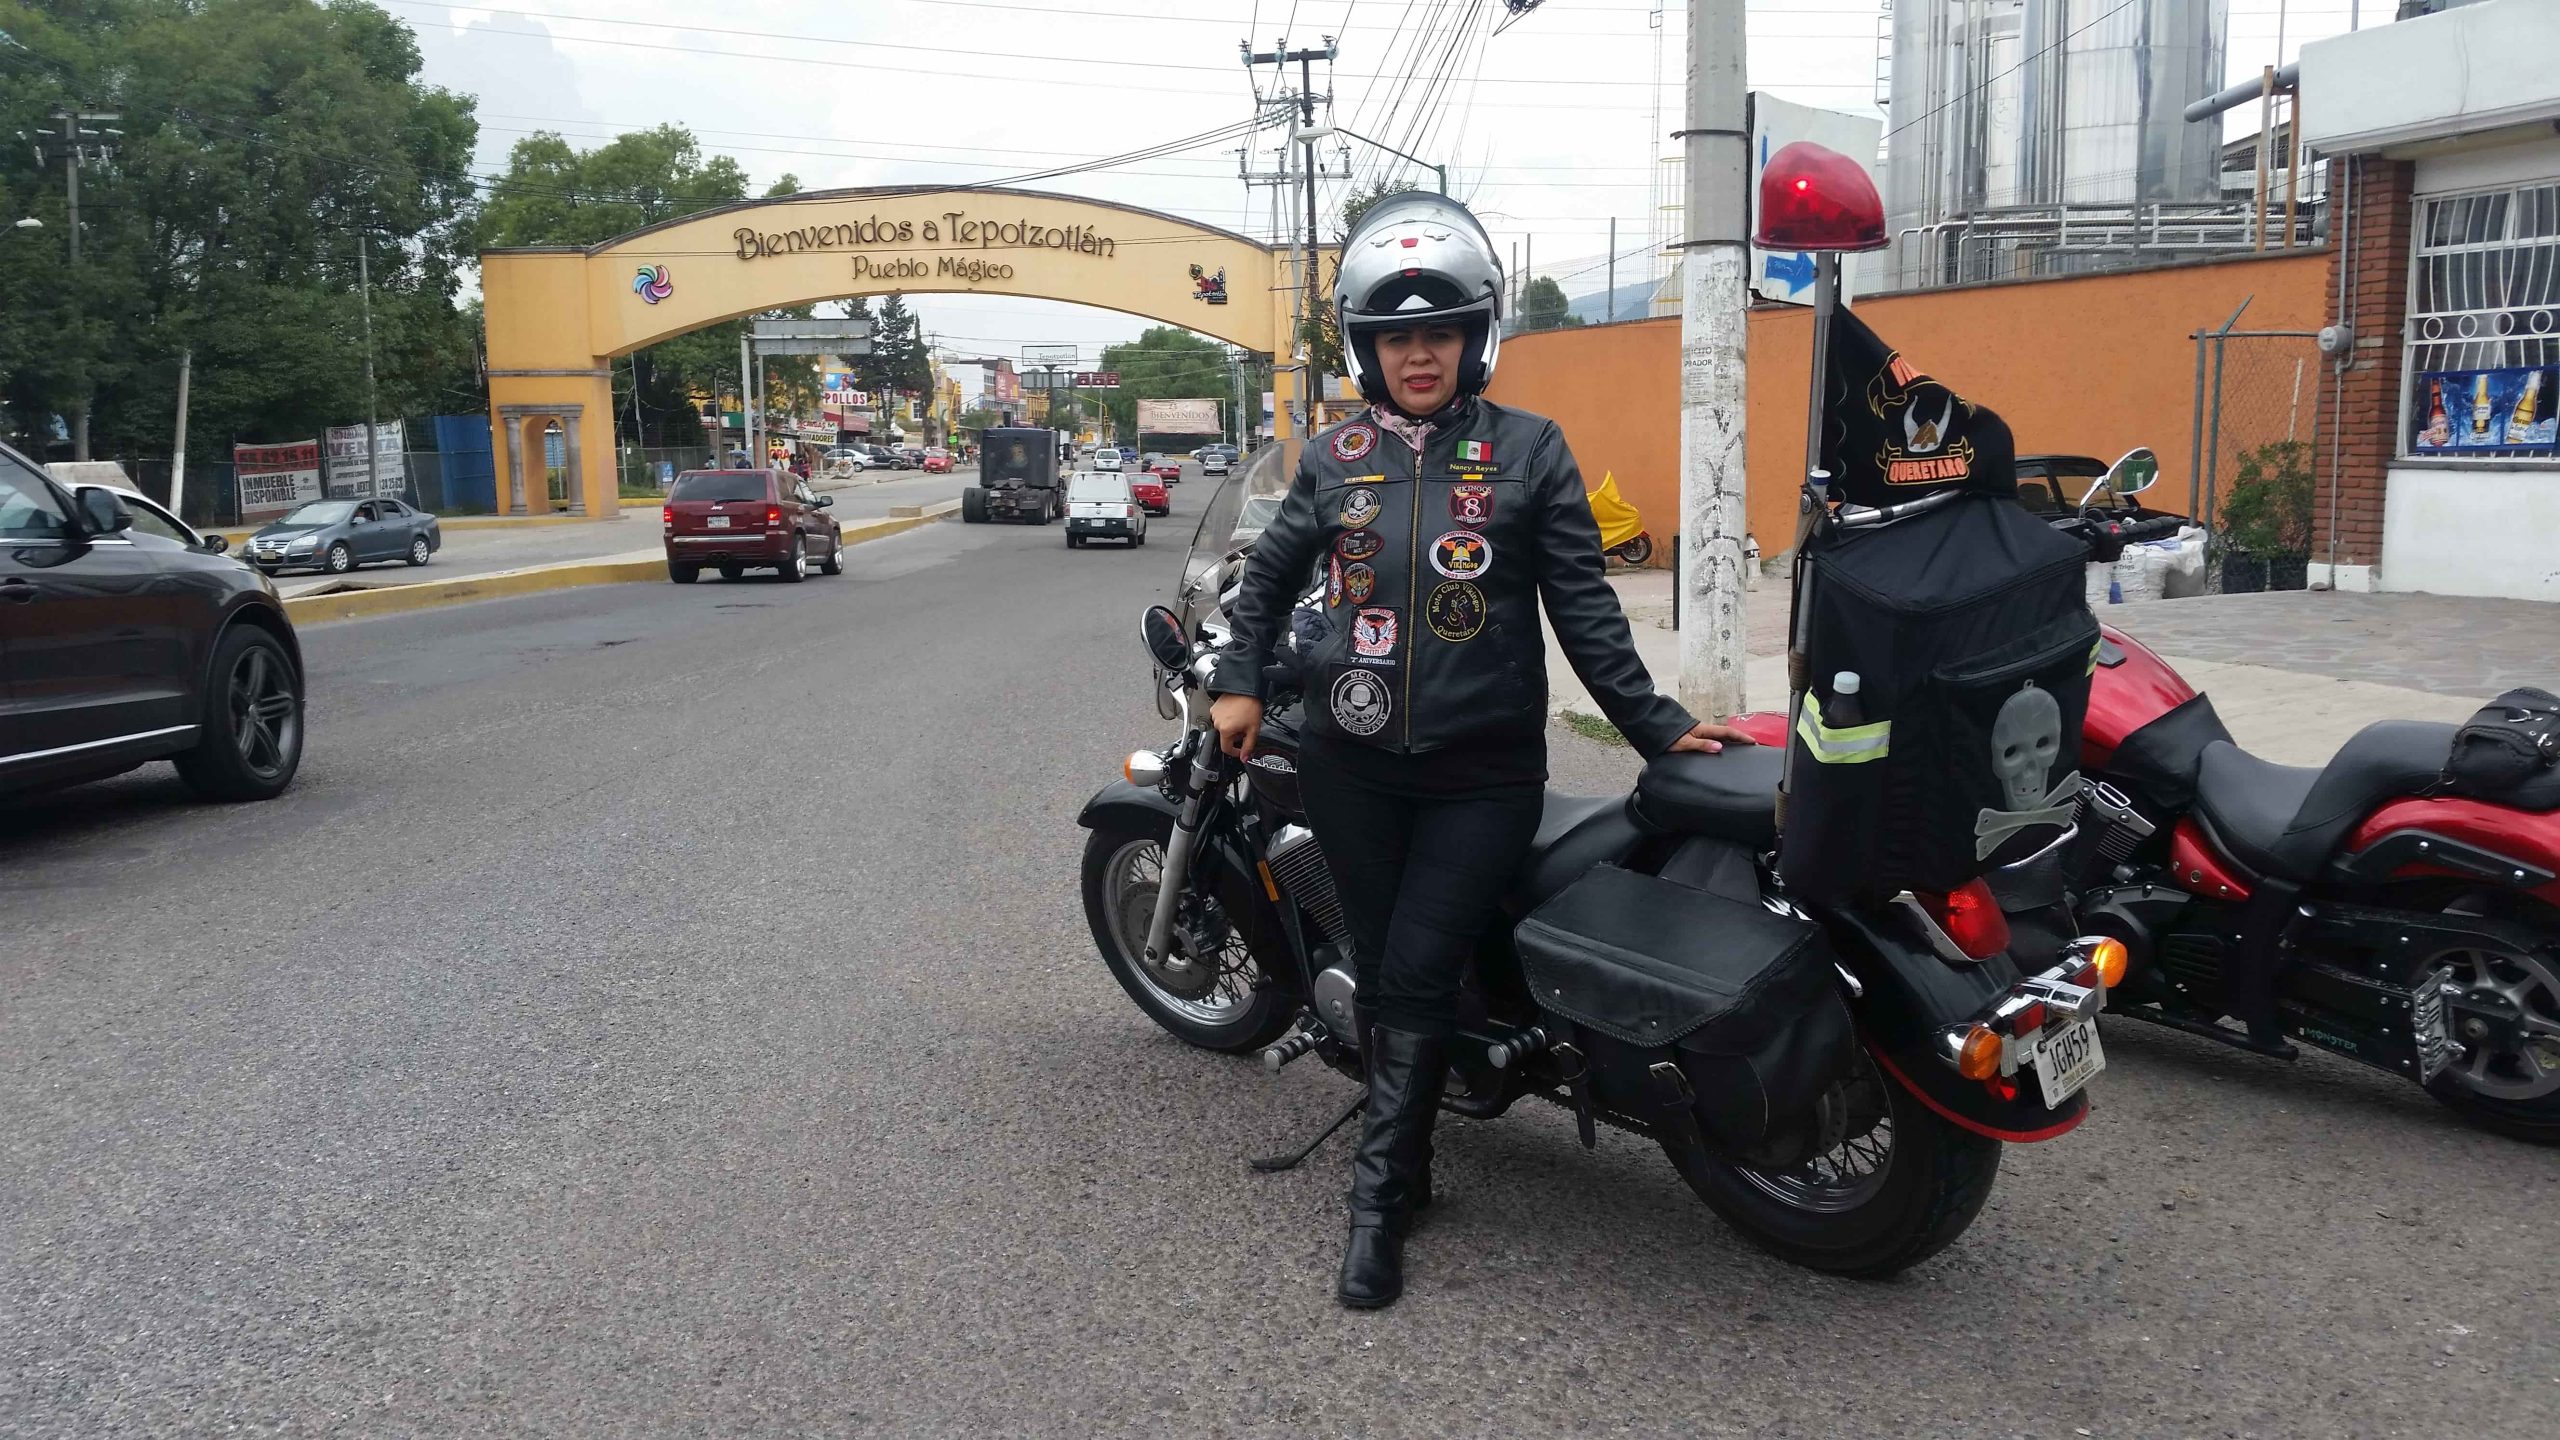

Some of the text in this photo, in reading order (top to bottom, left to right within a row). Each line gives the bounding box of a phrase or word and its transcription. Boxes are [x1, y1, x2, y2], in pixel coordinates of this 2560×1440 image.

[734, 210, 1115, 260] Bienvenidos a Tepotzotlán
[852, 255, 1014, 282] Pueblo Mágico
[825, 392, 866, 405] POLLOS
[1449, 464, 1472, 472] Nancy
[1888, 457, 1967, 482] QUERETARO
[242, 474, 295, 491] INMUEBLE
[1453, 485, 1492, 494] VIKINGOS
[244, 488, 297, 504] DISPONIBLE
[1465, 498, 1480, 517] 8
[1455, 514, 1488, 524] ANIVERSARIO
[1432, 582, 1480, 613] Moto Club Vikingos
[1437, 625, 1475, 638] Queretaro
[1359, 657, 1396, 666] ANIVERSARIO
[1350, 671, 1374, 680] MCU
